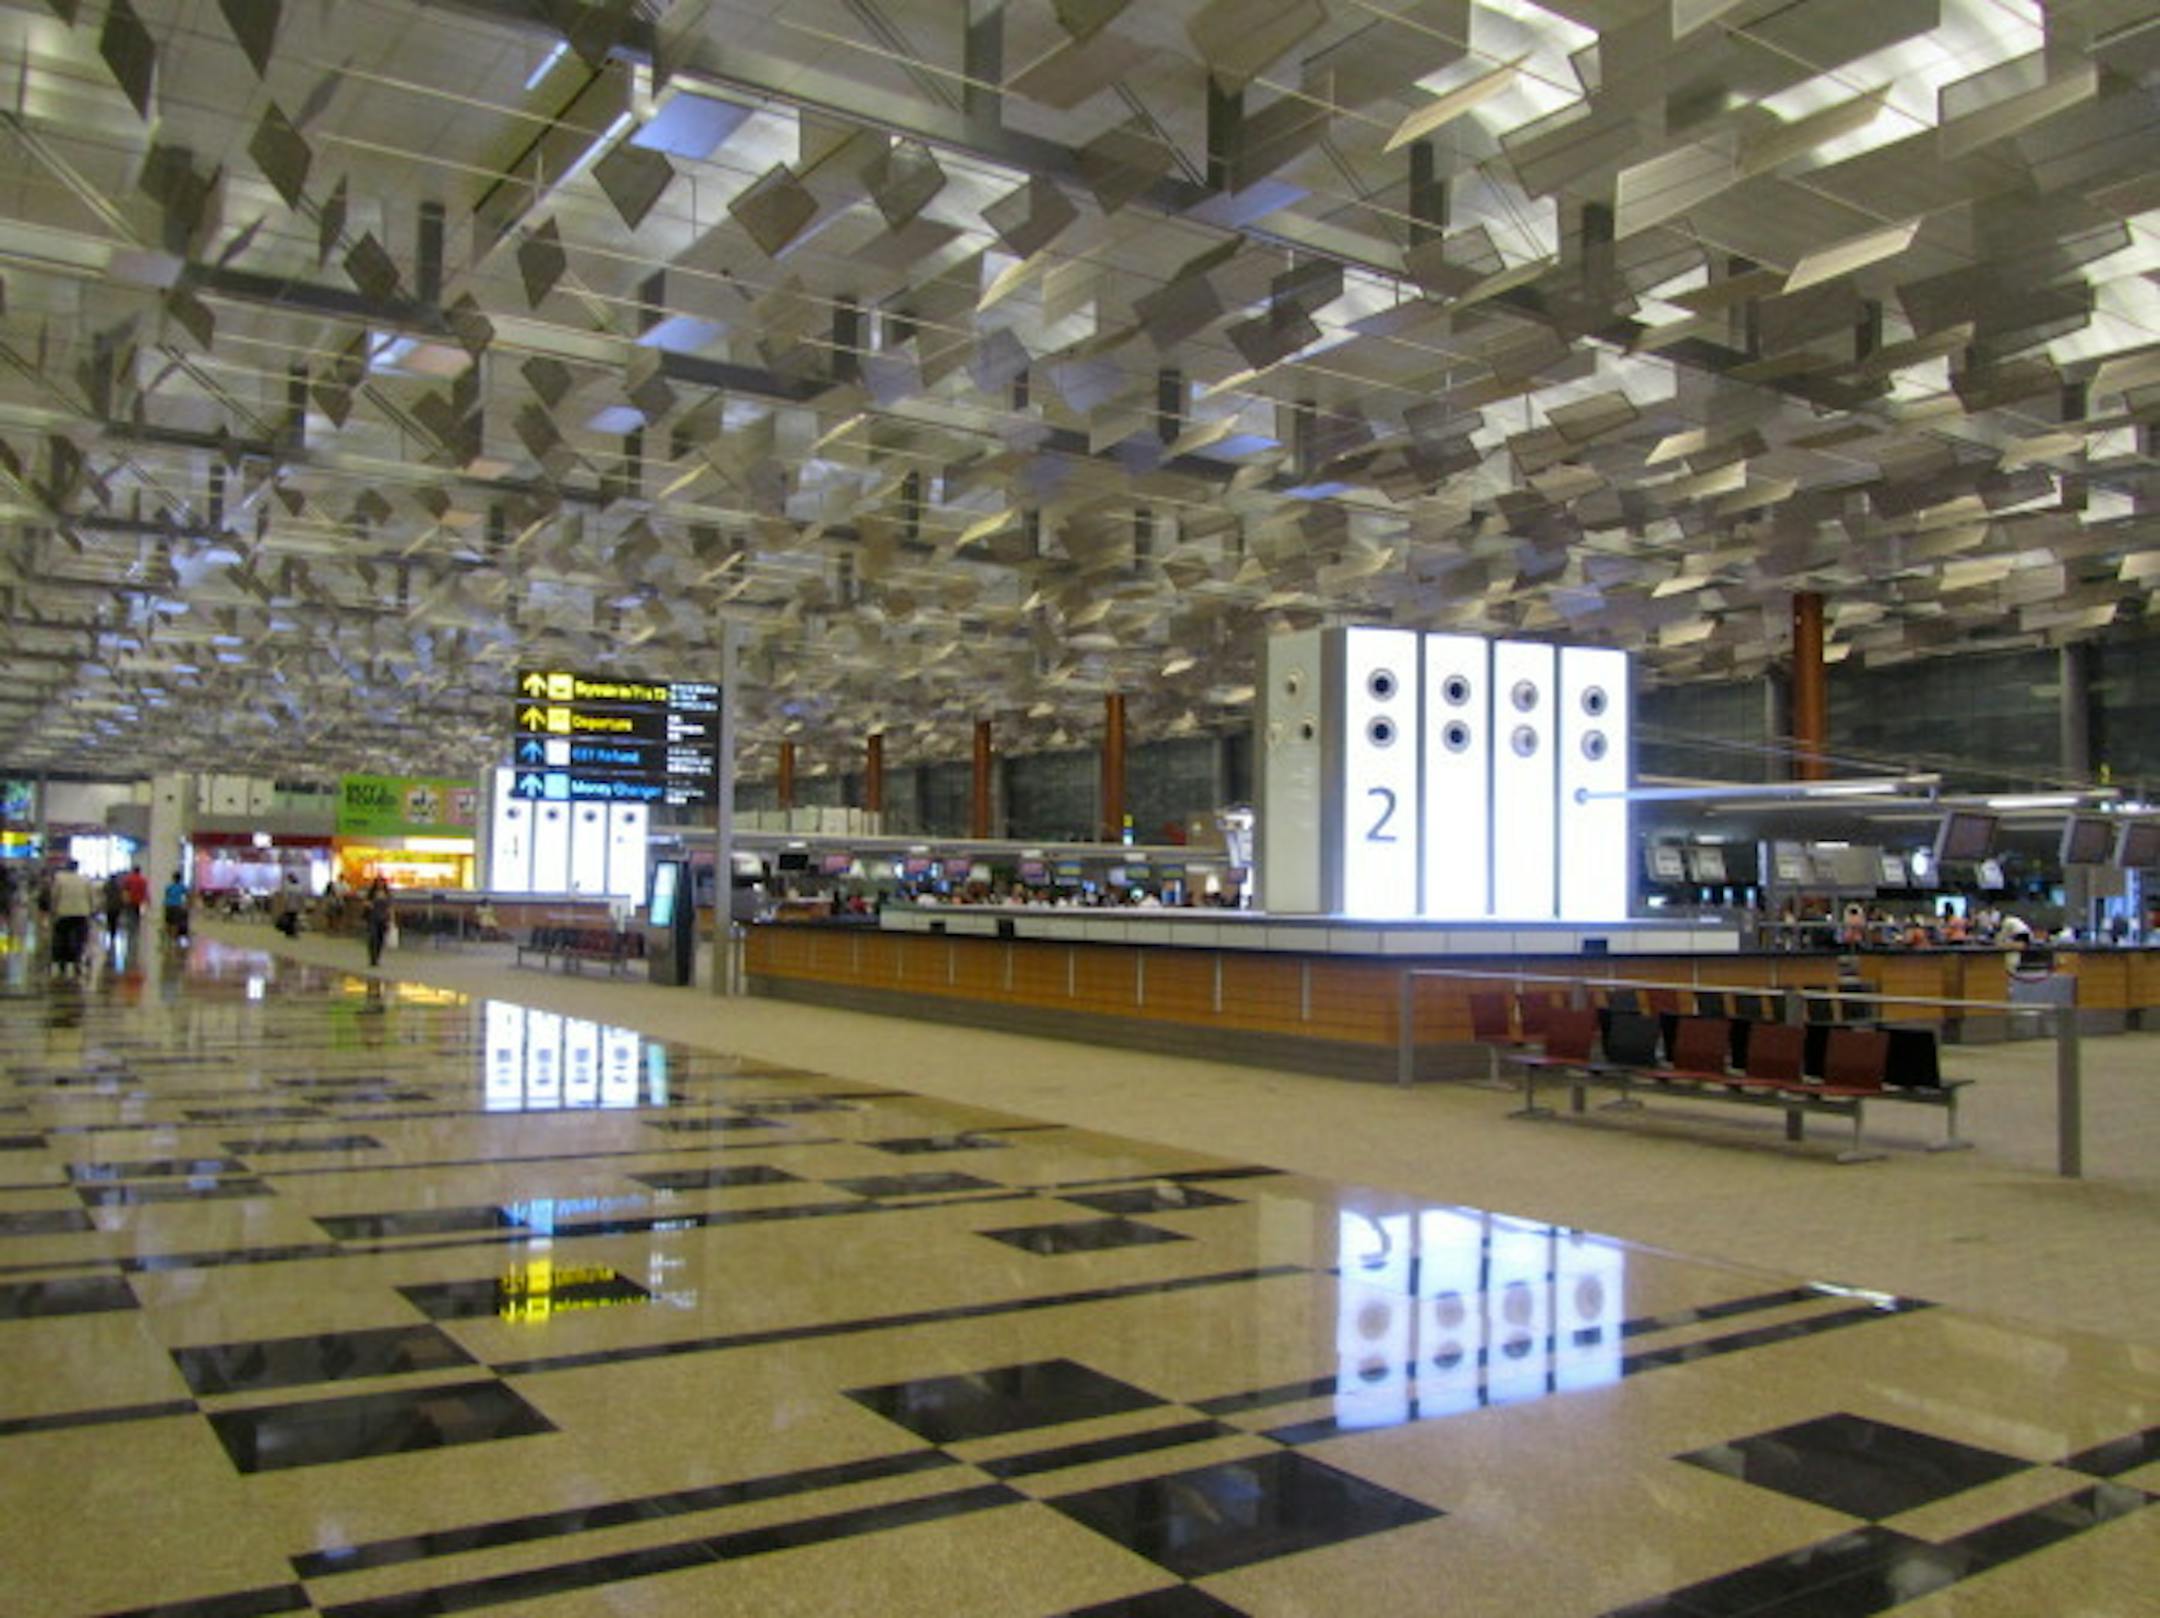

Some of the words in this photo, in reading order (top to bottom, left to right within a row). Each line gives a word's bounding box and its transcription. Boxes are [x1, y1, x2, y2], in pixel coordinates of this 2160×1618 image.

[571, 779, 612, 797] Money
[613, 782, 663, 800] Changer
[1366, 788, 1396, 842] 2
